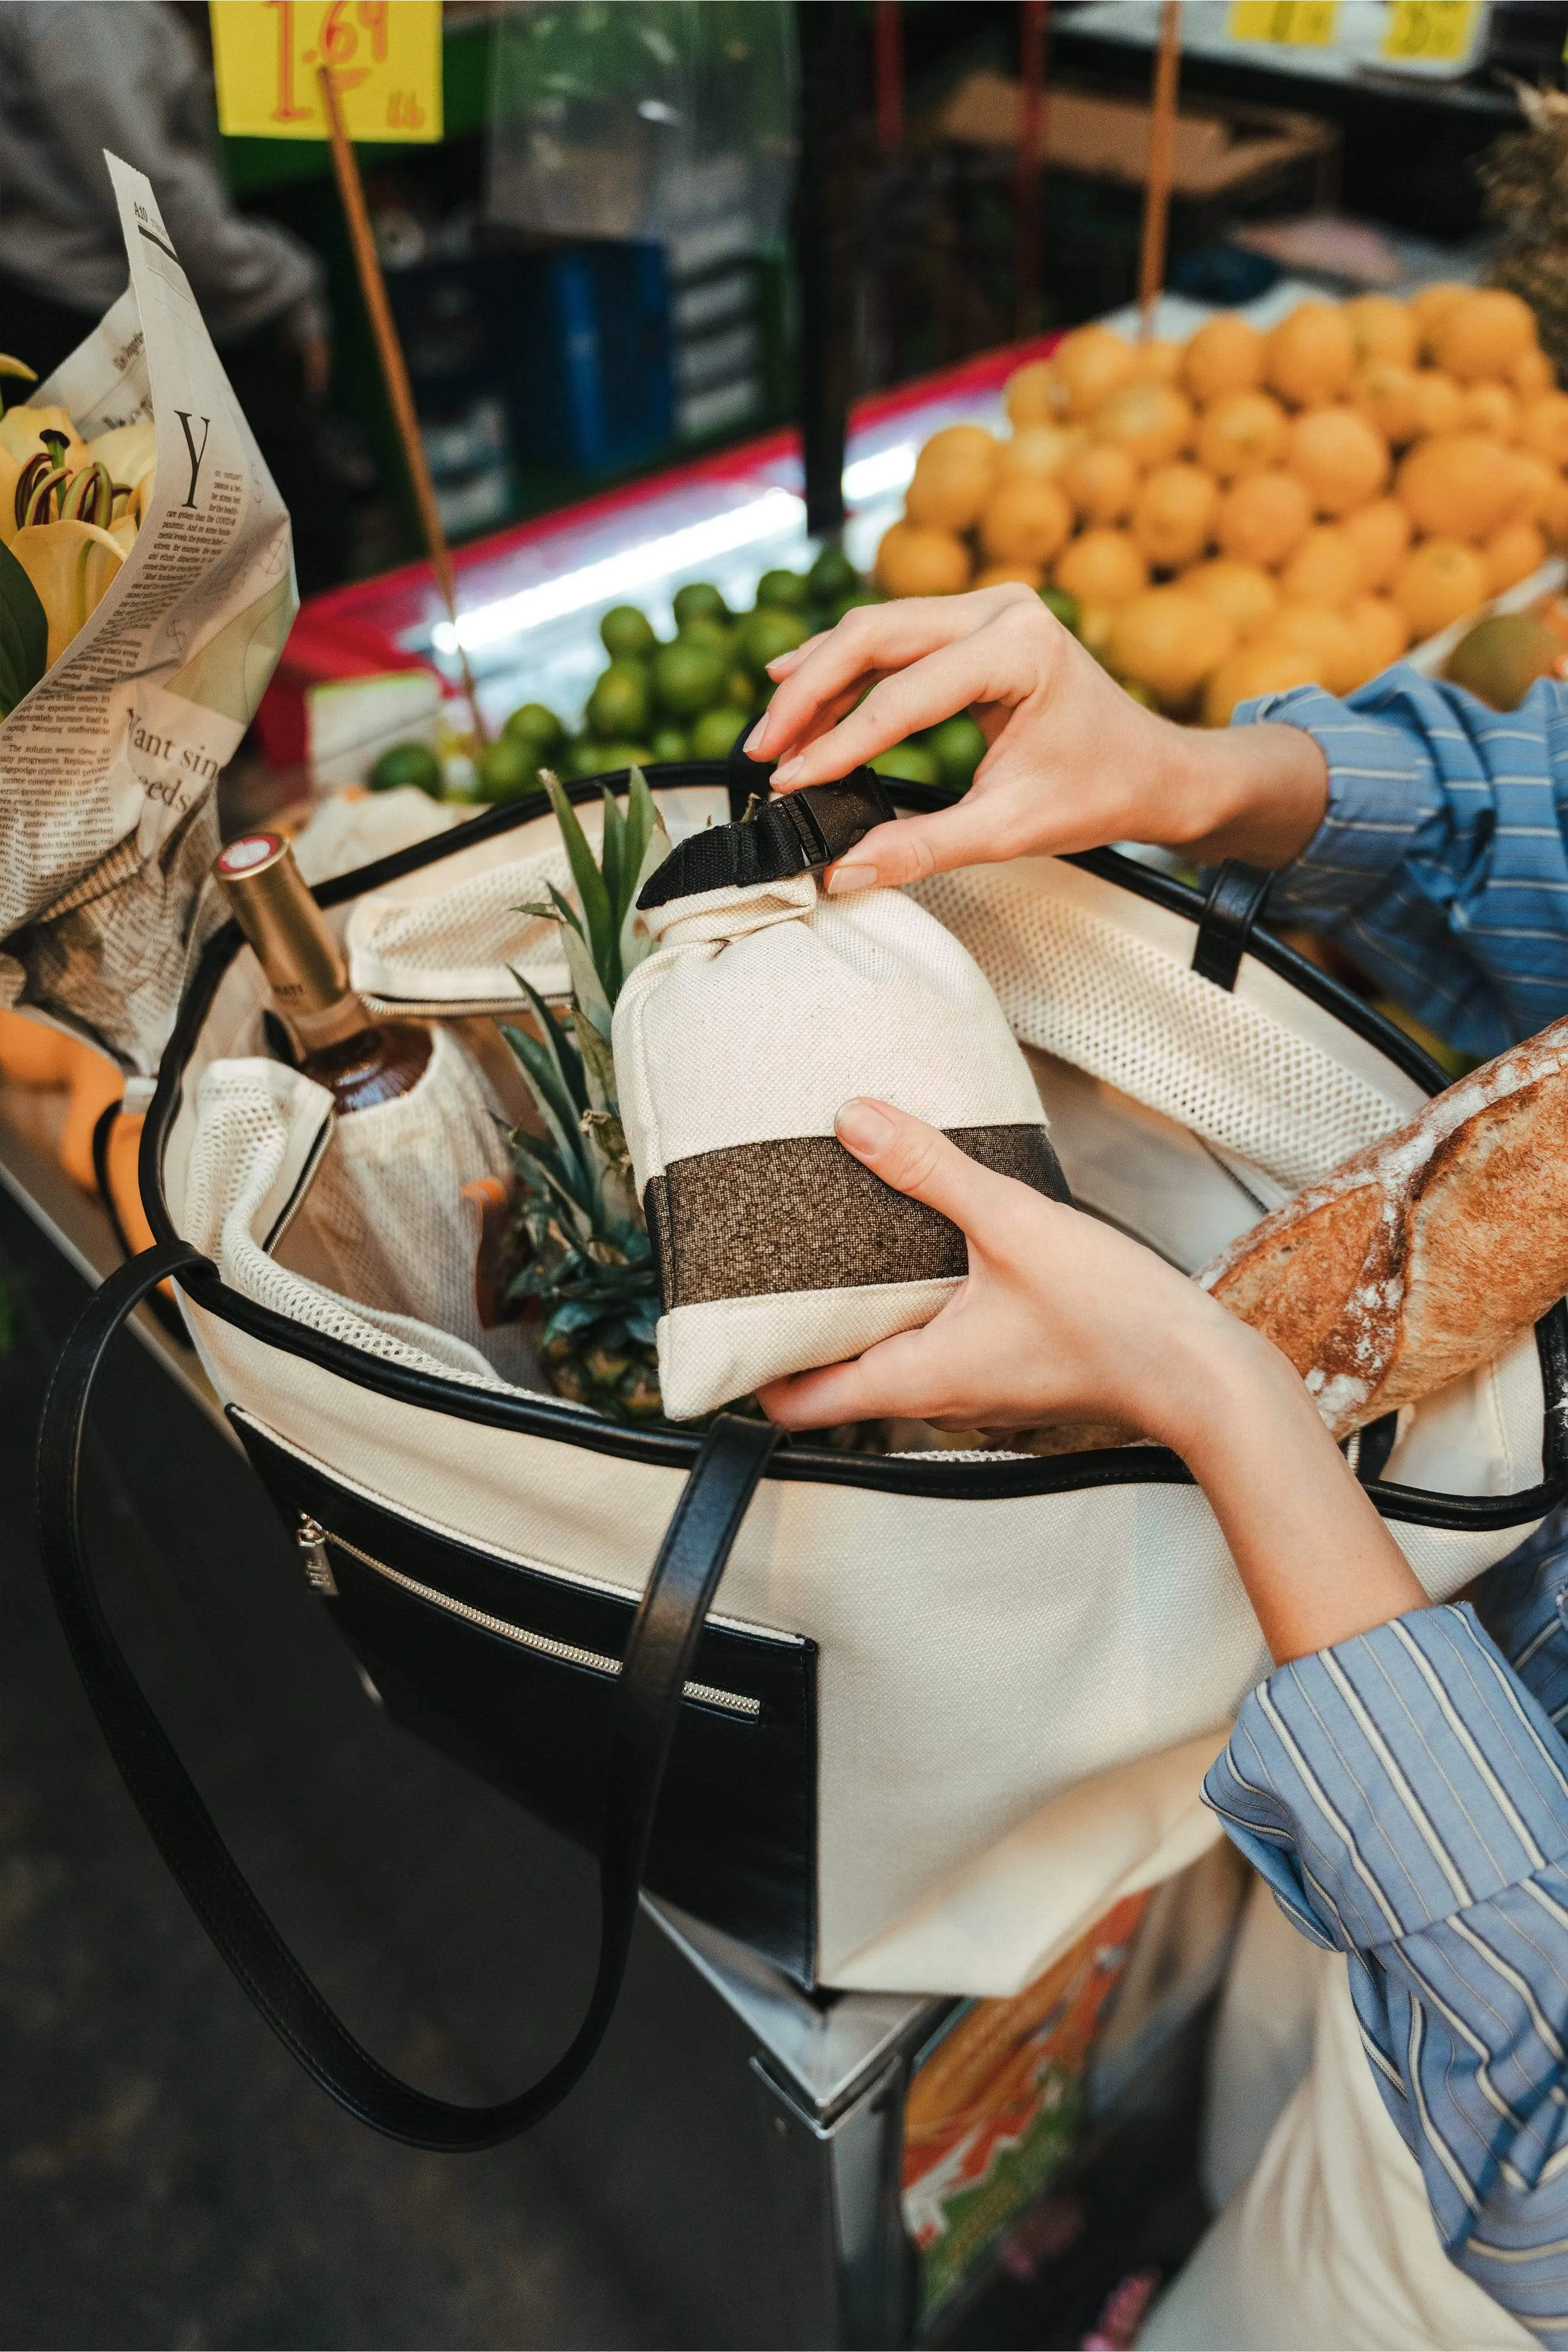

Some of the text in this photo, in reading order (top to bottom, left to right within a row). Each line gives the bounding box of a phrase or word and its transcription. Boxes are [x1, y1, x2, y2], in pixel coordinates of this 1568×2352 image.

[134, 201, 148, 223] A10
[173, 410, 210, 509] Y
[123, 650, 139, 659] wrong
[32, 724, 63, 734] becoming
[25, 746, 53, 754] solution
[63, 756, 93, 766] Replace
[1, 766, 37, 775] dgepodge
[45, 767, 65, 776] public
[35, 799, 68, 807] financed
[74, 806, 112, 816] approach
[78, 817, 113, 826] everyone
[63, 830, 82, 838] they
